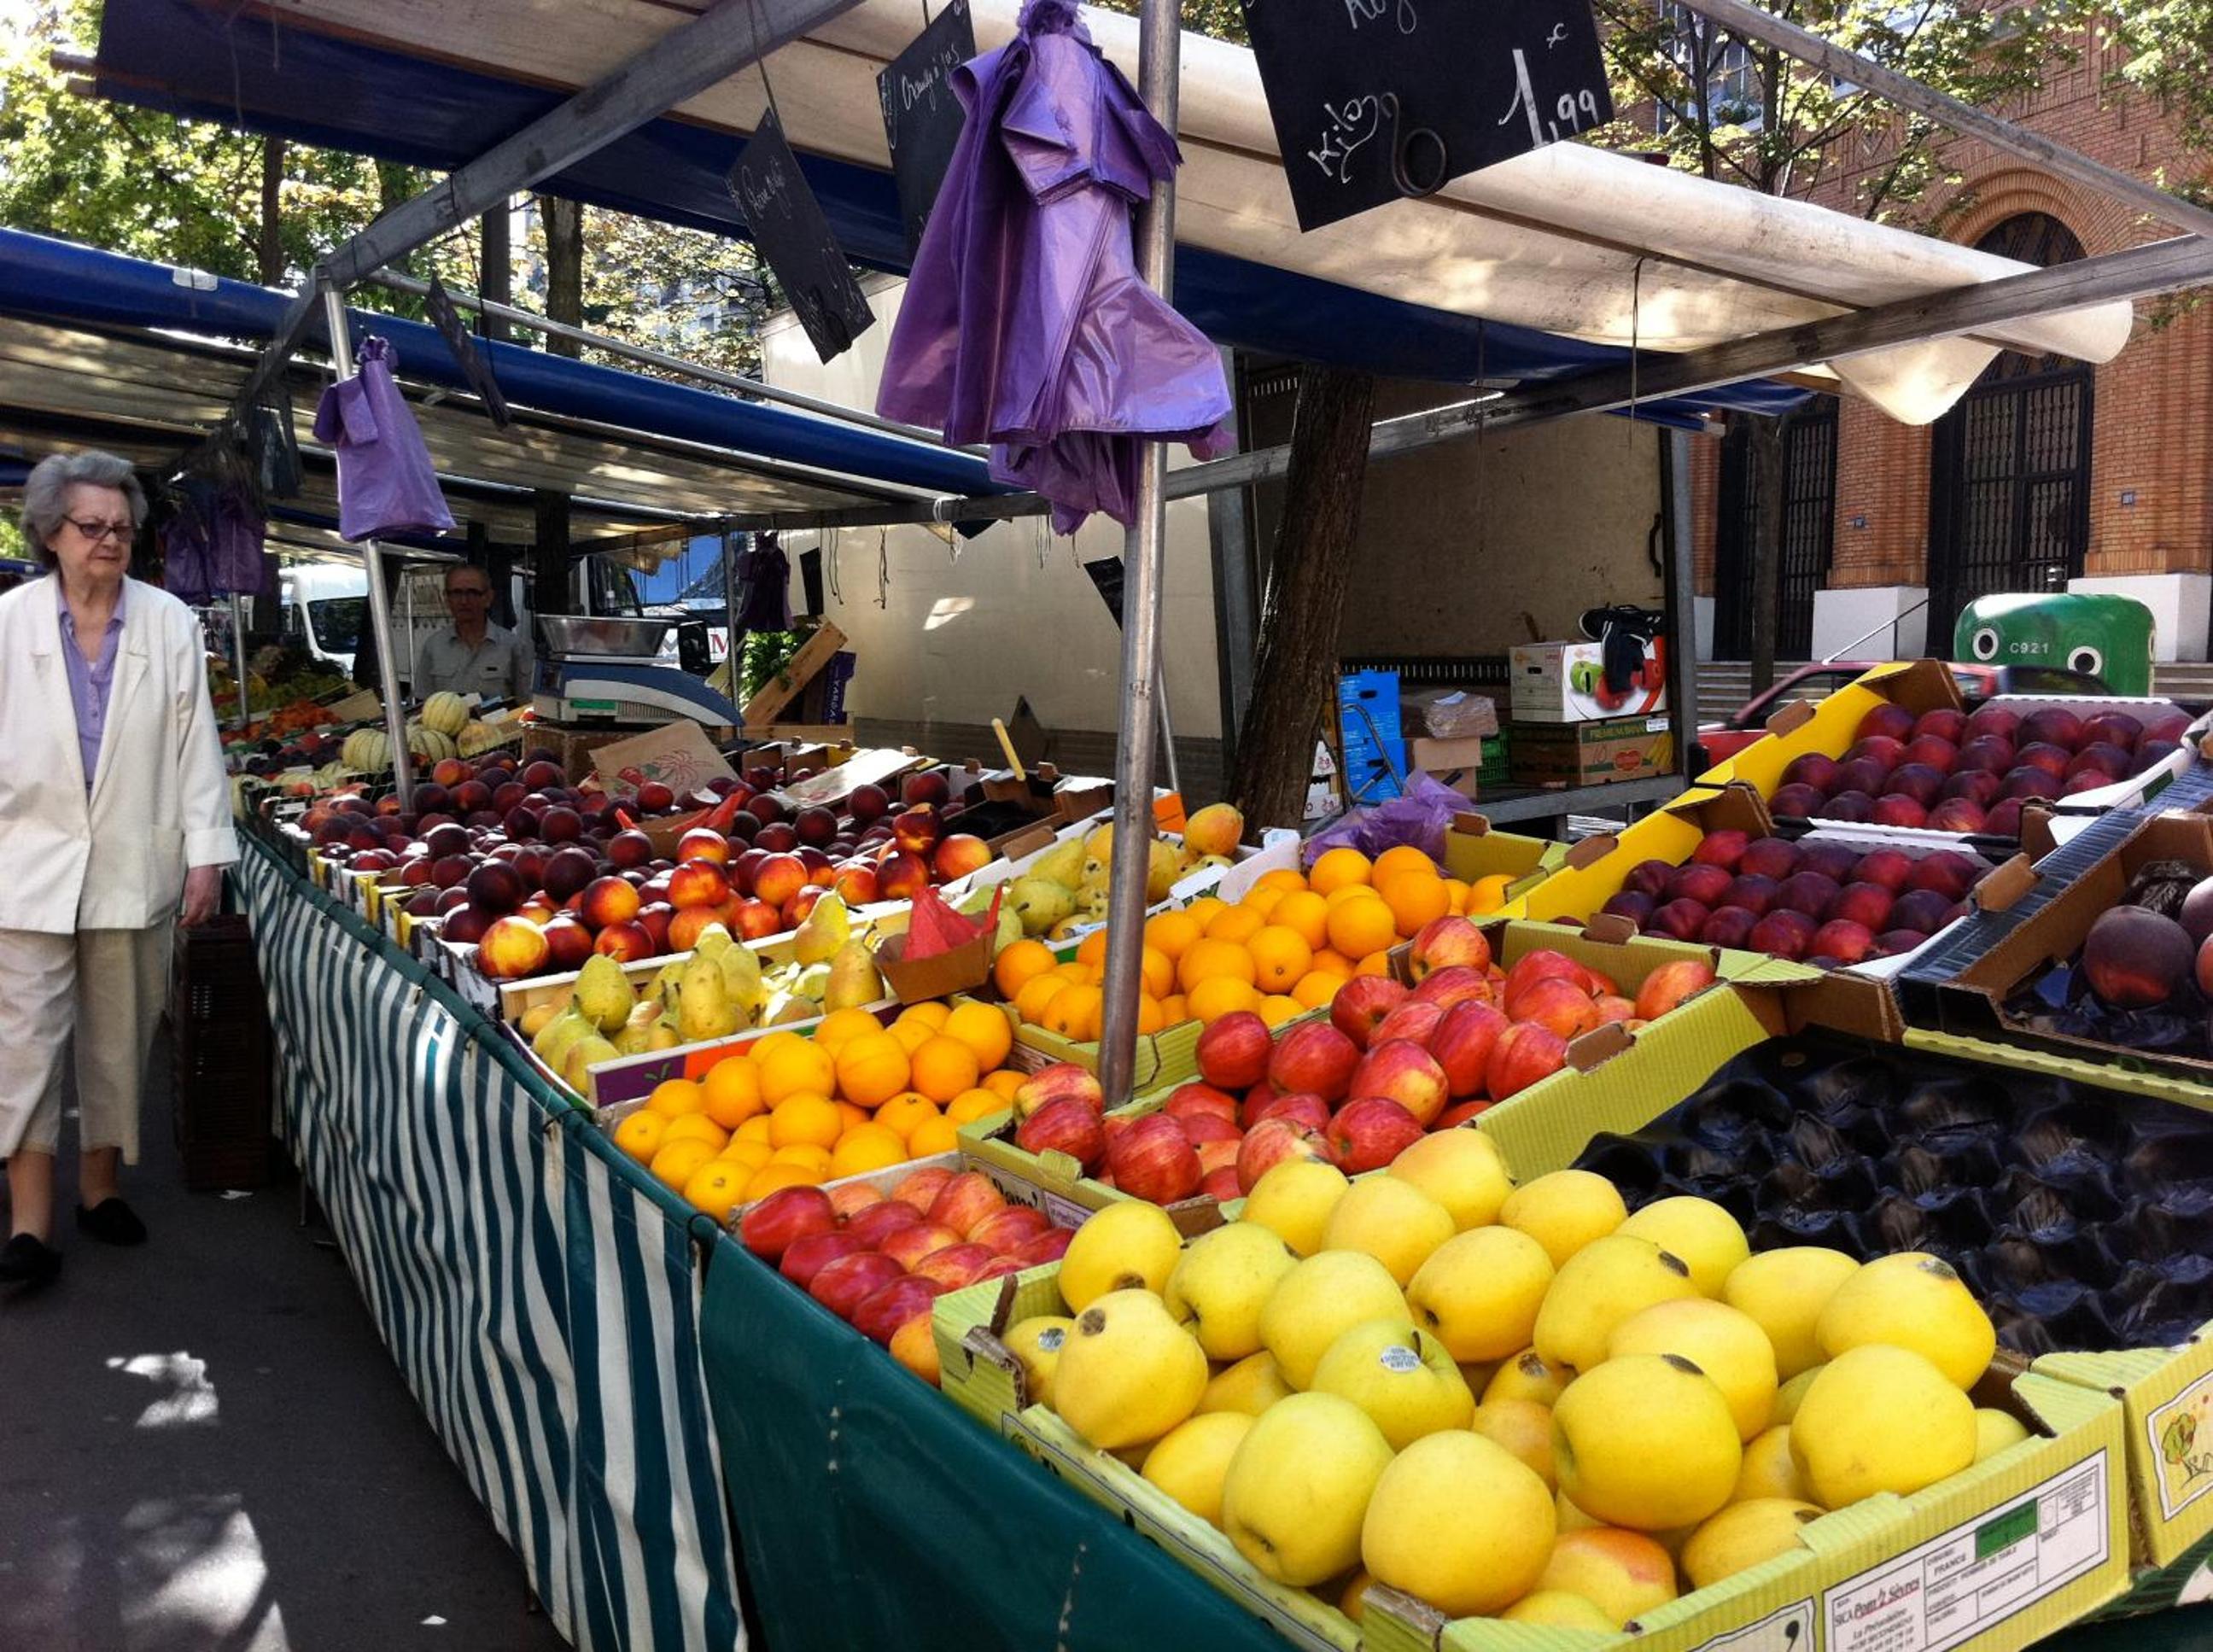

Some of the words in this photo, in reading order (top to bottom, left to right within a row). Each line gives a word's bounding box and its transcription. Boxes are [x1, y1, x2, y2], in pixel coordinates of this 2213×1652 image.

[1307, 94, 1379, 184] Kilo
[1498, 48, 1599, 150] 1,99
[2010, 642, 2050, 654] C921
